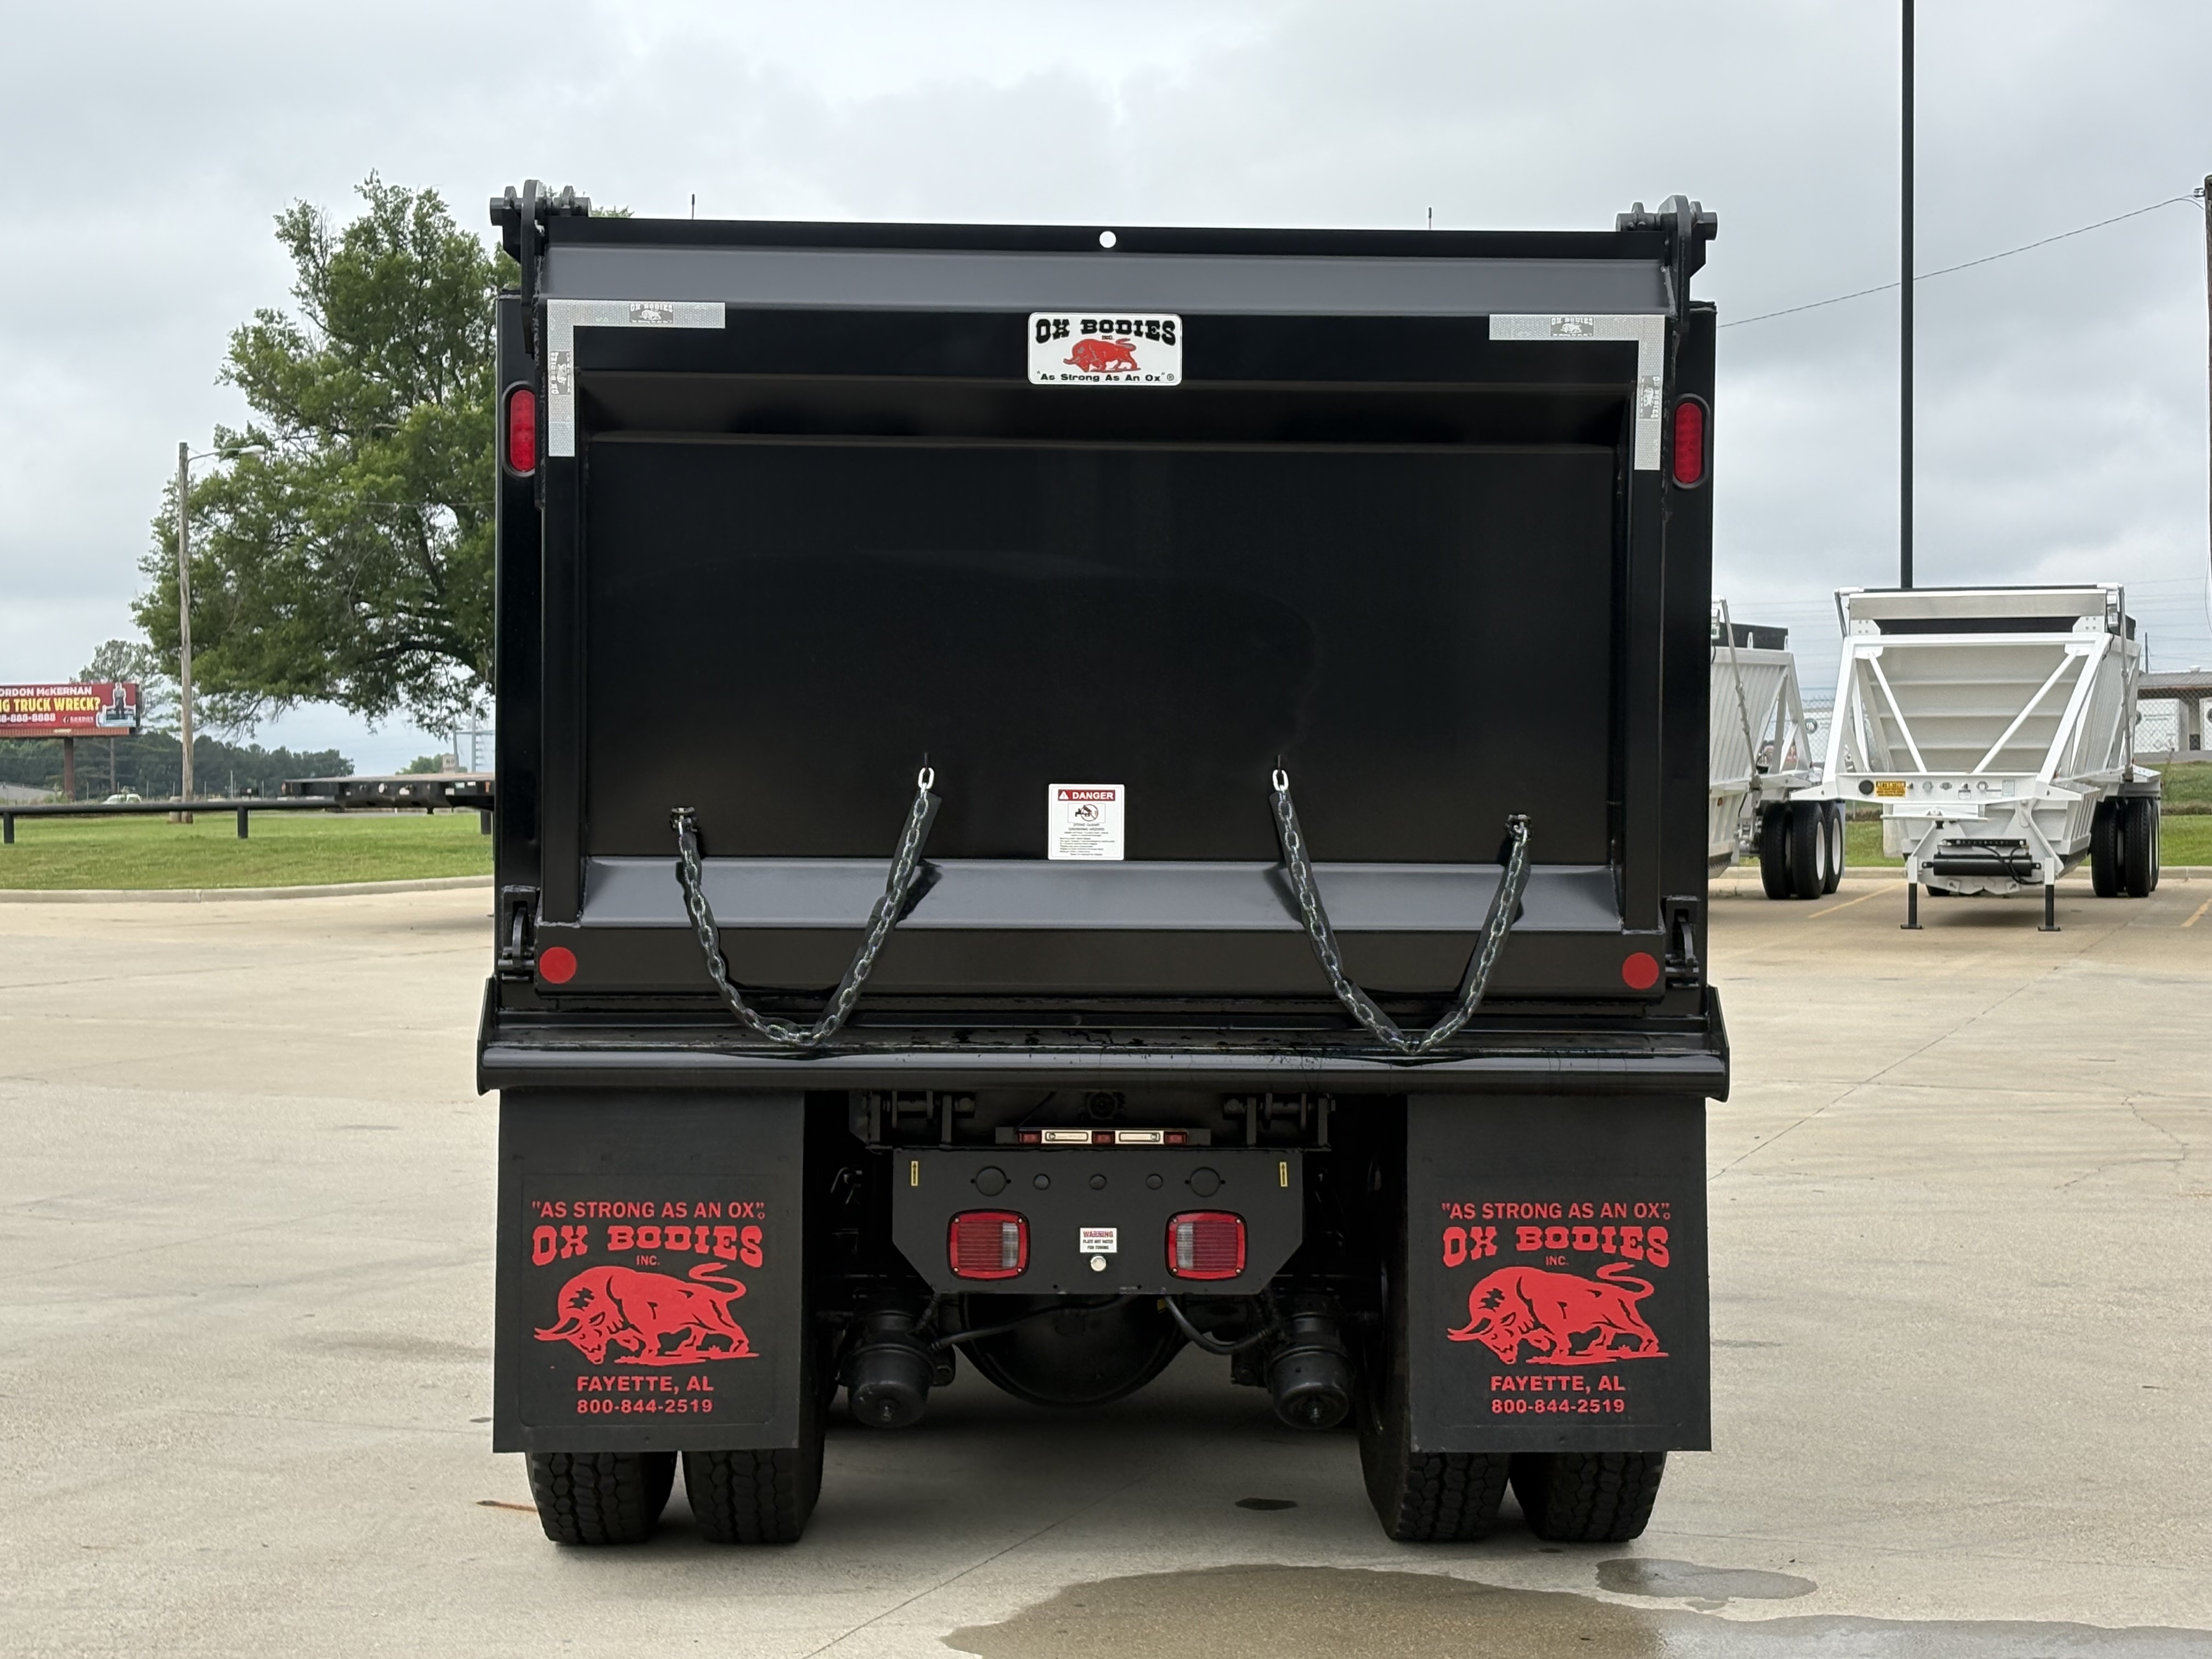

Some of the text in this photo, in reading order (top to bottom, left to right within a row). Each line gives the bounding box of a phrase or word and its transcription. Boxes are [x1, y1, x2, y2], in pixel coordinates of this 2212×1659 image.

[1036, 319, 1176, 346] OX BODIES
[1060, 374, 1099, 382] Strong
[14, 697, 52, 713] TRUCK
[54, 697, 100, 712] WRECK?
[0, 713, 55, 723] 8-888-8888
[573, 1201, 654, 1219] STRONG
[661, 1202, 687, 1218] AS
[694, 1202, 721, 1218] AN
[1482, 1203, 1562, 1220] STRONG
[1568, 1203, 1594, 1219] AS
[1600, 1203, 1627, 1219] AN
[532, 1225, 763, 1267] OX BODIES
[1443, 1226, 1669, 1268] OX BODIES
[636, 1256, 660, 1266] INC.
[1545, 1256, 1568, 1266] INC.
[577, 1376, 714, 1393] FAYETTE, AL
[1491, 1376, 1626, 1393] FAYETTE, AL
[577, 1399, 713, 1413] 800-844-2519
[1492, 1399, 1624, 1413] 800-844-2519
